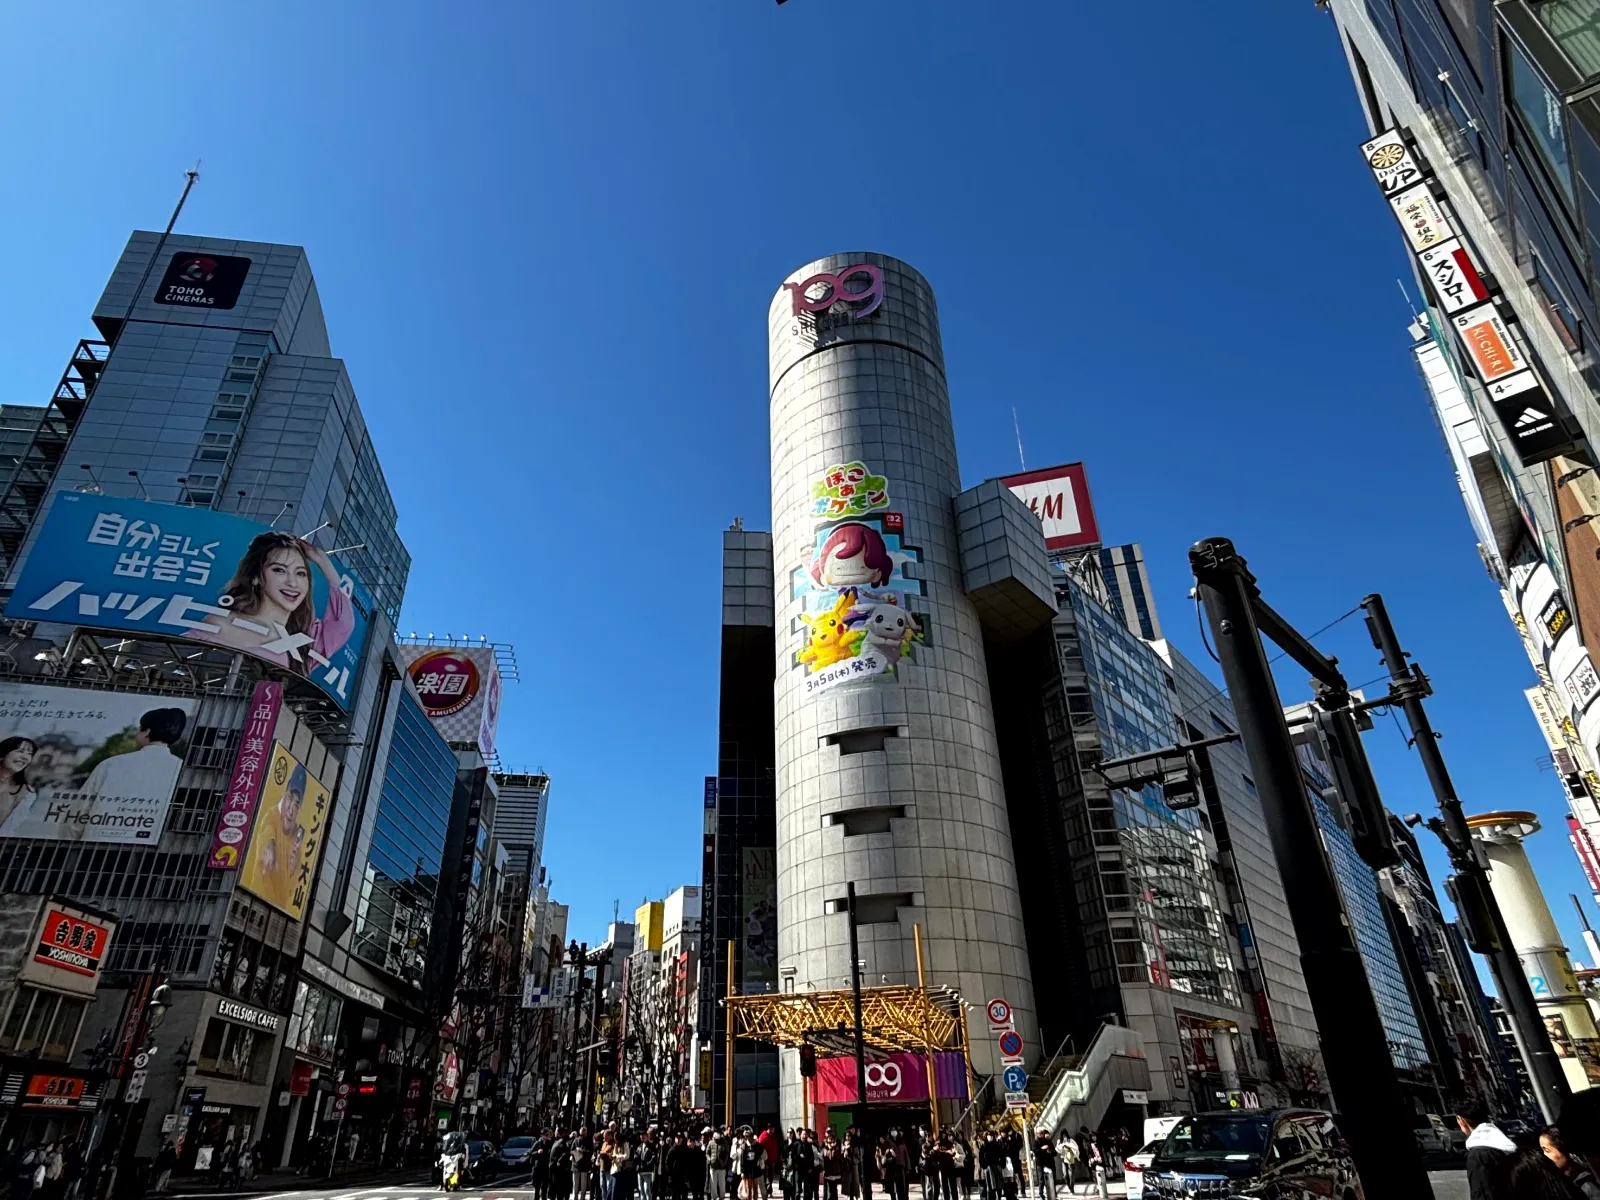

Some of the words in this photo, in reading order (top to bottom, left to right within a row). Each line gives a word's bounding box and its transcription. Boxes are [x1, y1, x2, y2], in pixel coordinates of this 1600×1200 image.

[1379, 160, 1411, 179] Darts
[1380, 168, 1417, 191] UP
[169, 285, 204, 295] TOHO
[783, 263, 884, 319] 109
[1432, 259, 1464, 306] スシロー
[164, 293, 215, 305] CINEMAS
[826, 466, 864, 489] ぽこ
[839, 483, 856, 497] あ
[811, 490, 885, 514] ポケモン
[87, 512, 220, 560] 自分らしく
[112, 551, 211, 586] 出会う
[28, 580, 348, 700] ハッピーメール
[416, 672, 470, 695] 楽園
[430, 693, 473, 717] AMUSEMENT
[230, 704, 272, 810] 品川美容外科
[64, 810, 155, 828] Healmate
[292, 793, 325, 910] キング大山
[55, 920, 97, 953] 吉野家
[218, 1000, 257, 1023] EXCELSIOR
[993, 1006, 1006, 1017] 30
[137, 1054, 146, 1066] 3
[1008, 1073, 1018, 1089] P
